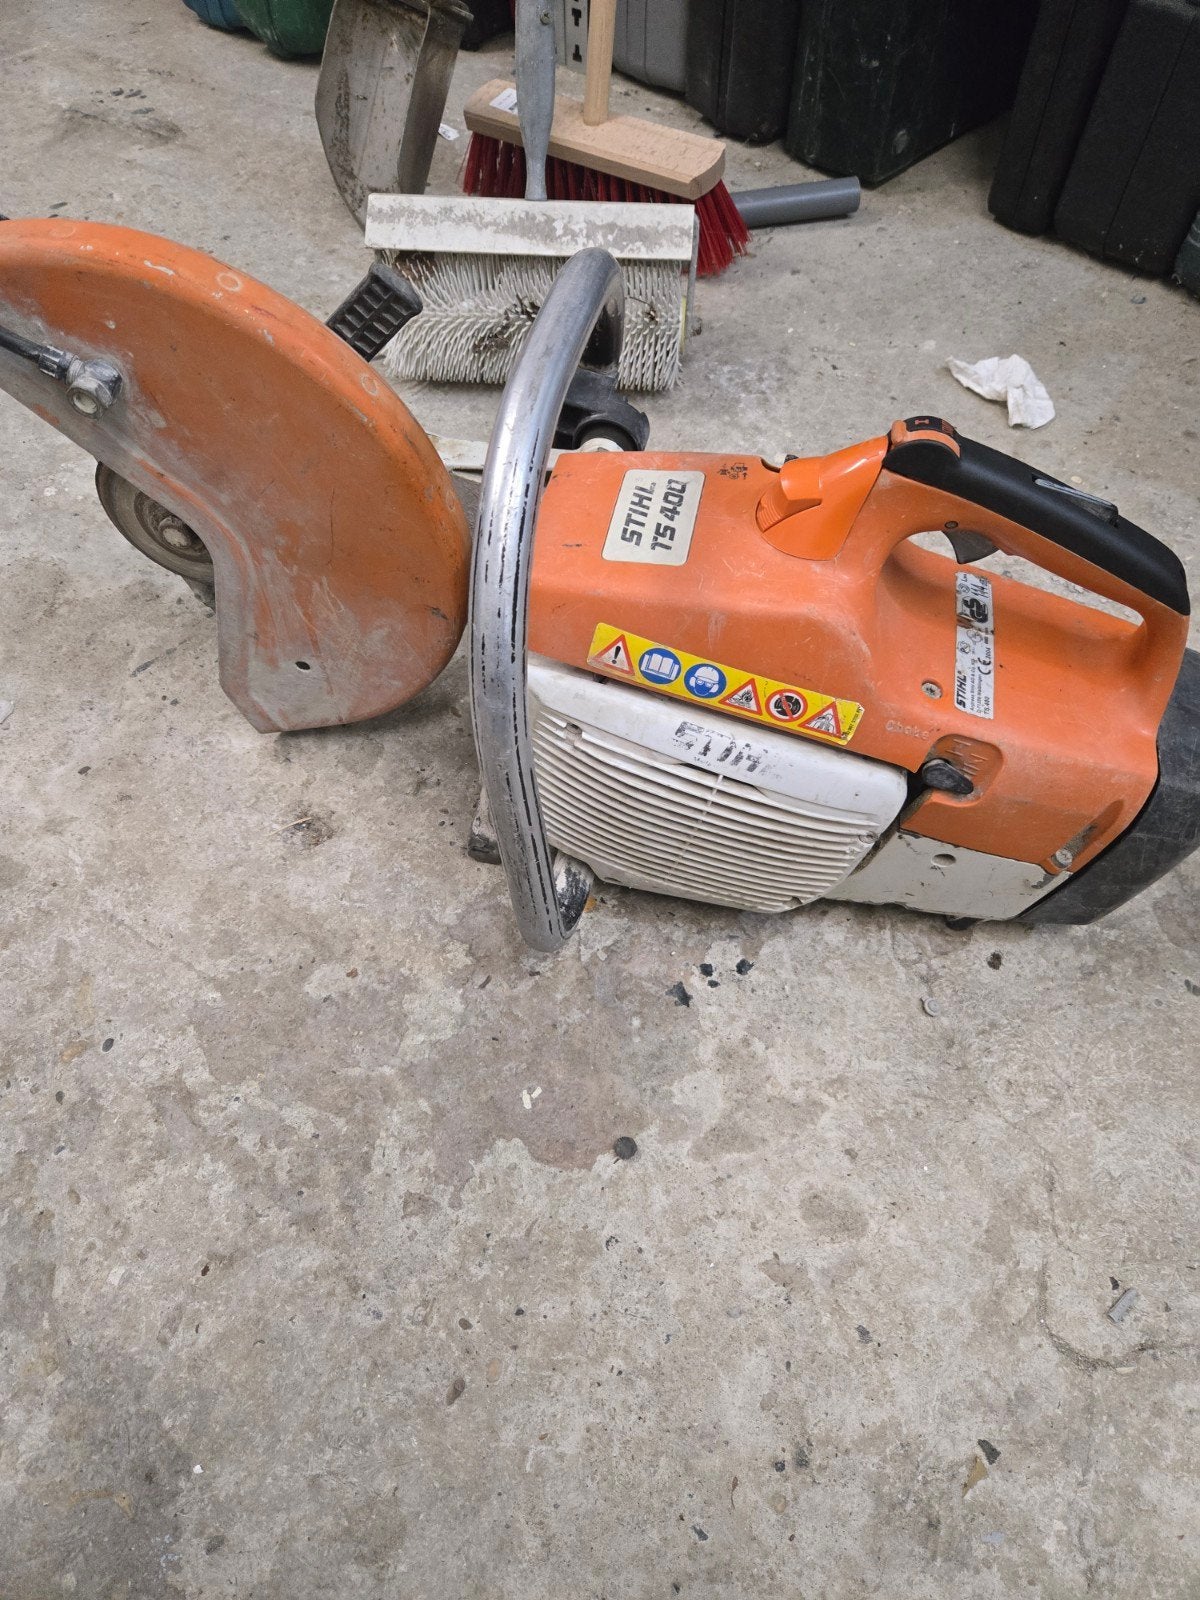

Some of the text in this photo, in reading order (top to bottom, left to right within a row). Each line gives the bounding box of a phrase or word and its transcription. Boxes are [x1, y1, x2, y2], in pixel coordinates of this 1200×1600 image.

[620, 482, 656, 546] STIHL
[650, 479, 687, 550] TS 400
[957, 675, 967, 708] STIHL
